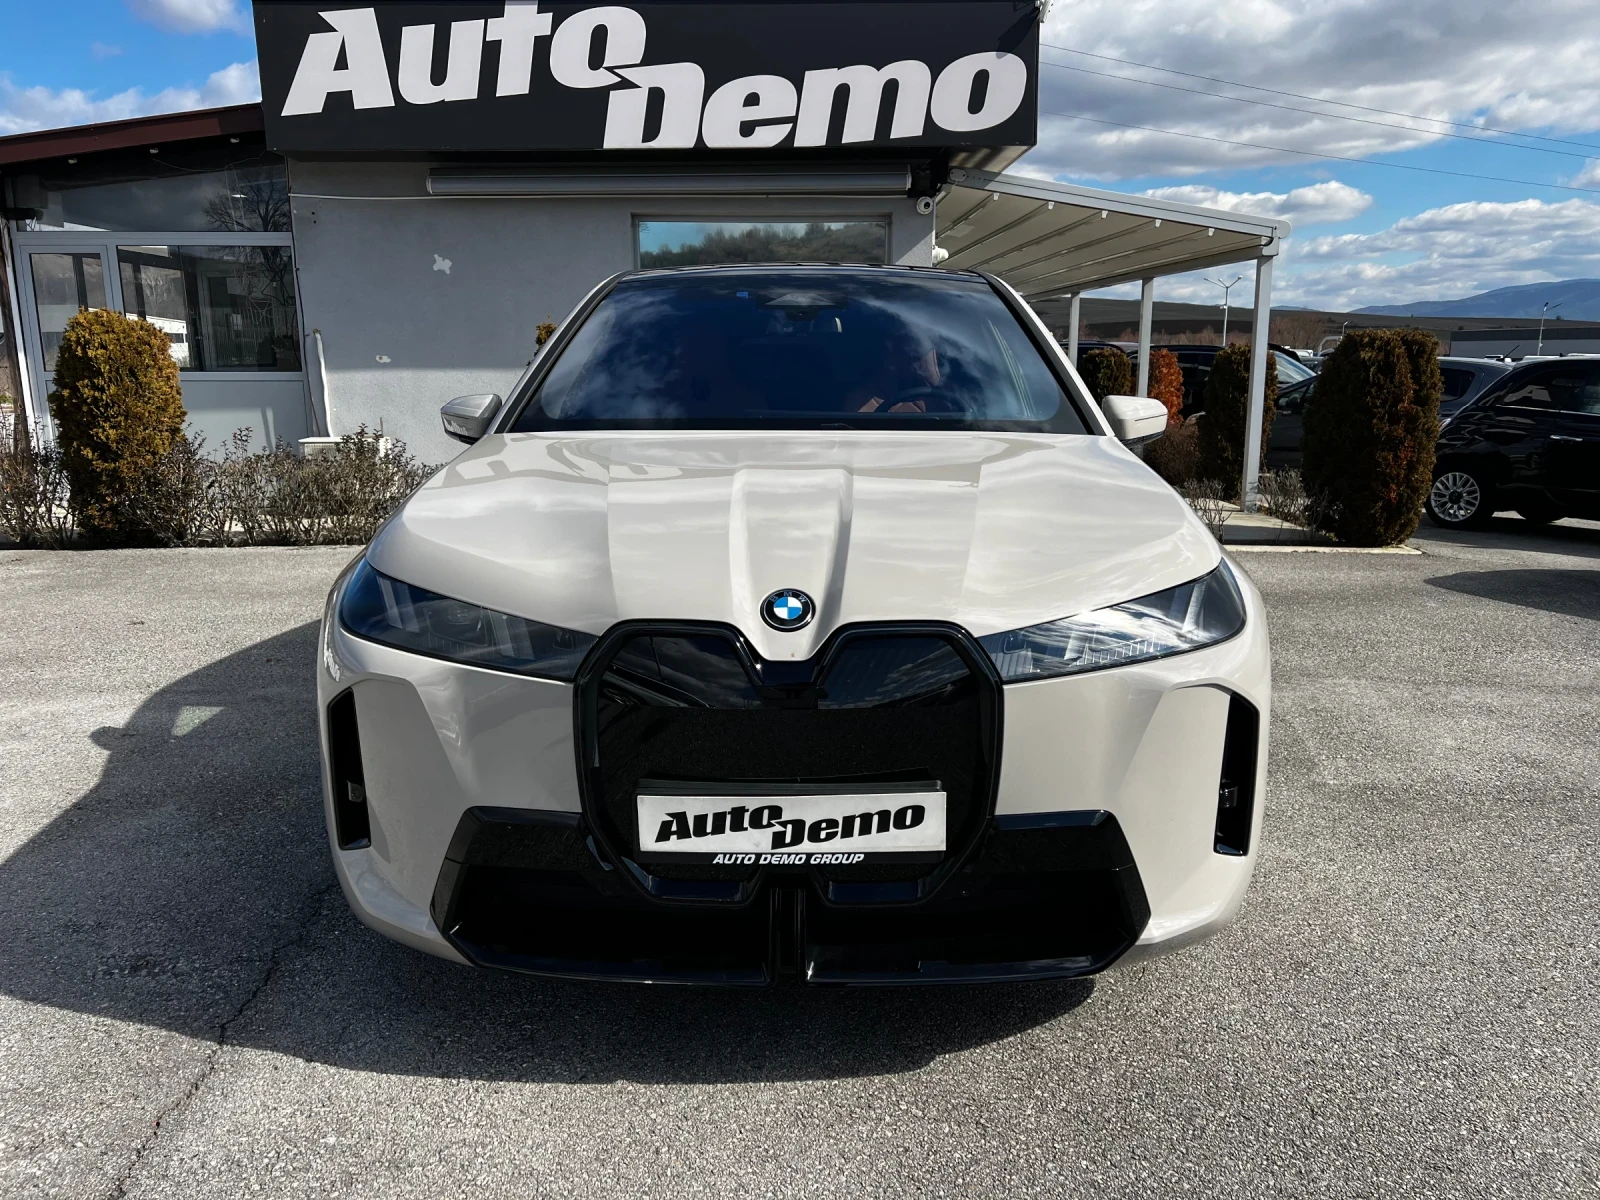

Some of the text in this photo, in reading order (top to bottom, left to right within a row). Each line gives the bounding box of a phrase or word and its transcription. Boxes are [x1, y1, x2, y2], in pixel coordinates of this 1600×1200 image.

[281, 0, 1027, 149] Auto Demo
[769, 590, 808, 603] BMW
[655, 804, 926, 850] Auto Demo
[712, 853, 865, 866] AUTO DEMO GROUP
